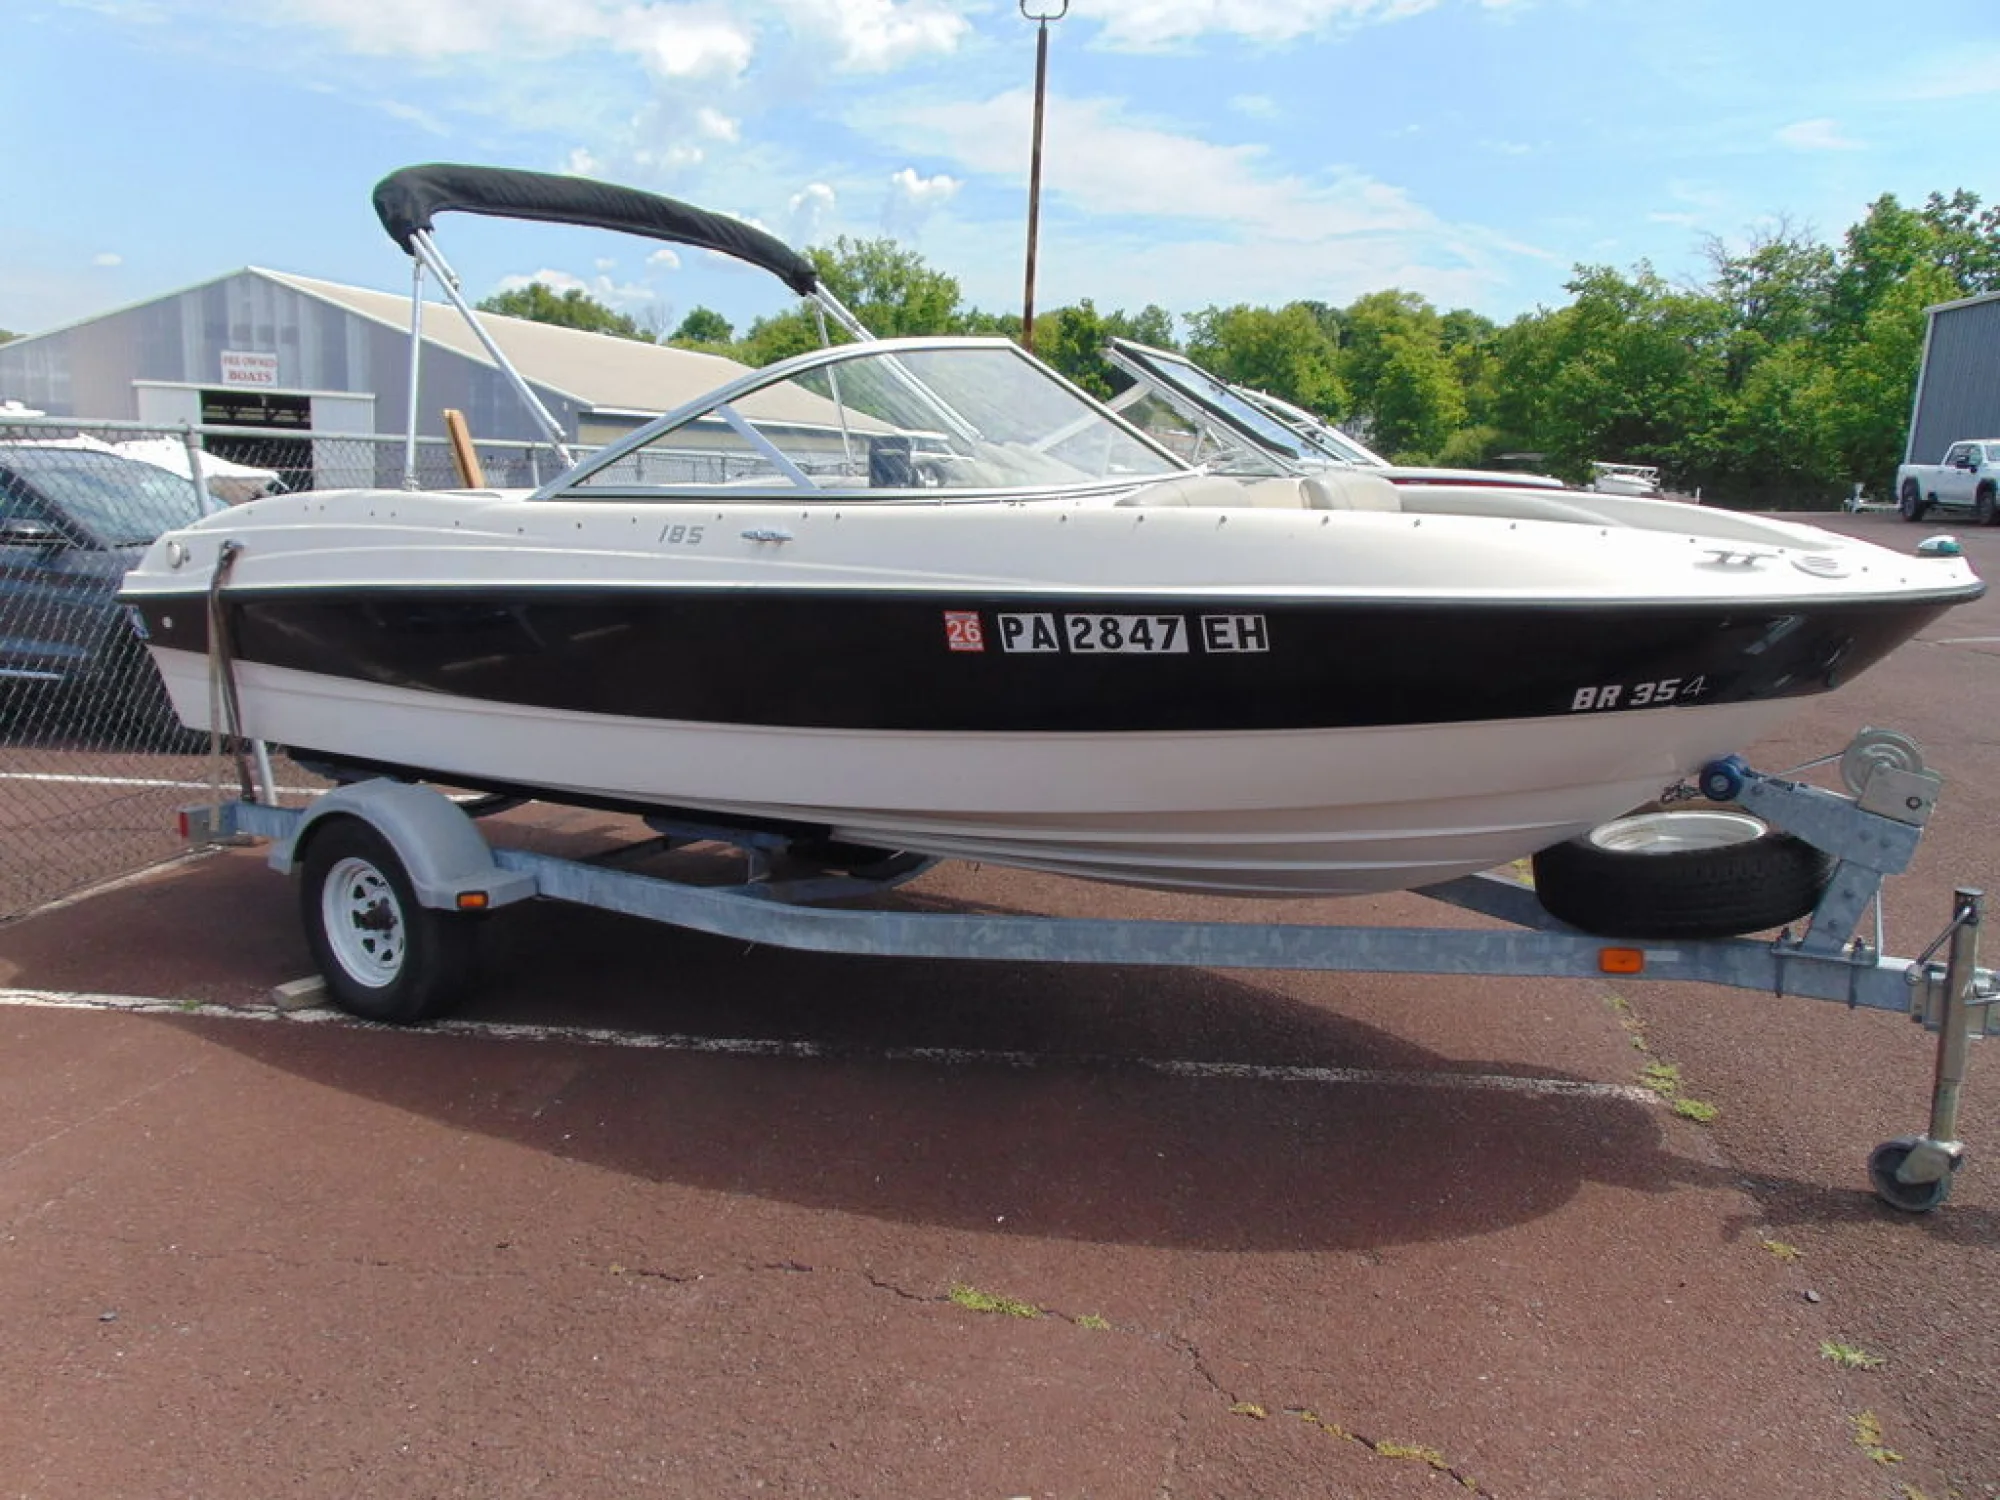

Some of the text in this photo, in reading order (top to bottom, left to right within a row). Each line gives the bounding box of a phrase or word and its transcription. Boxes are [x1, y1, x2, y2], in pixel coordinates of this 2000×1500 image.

[228, 370, 272, 382] BOATS
[658, 524, 704, 544] 185
[946, 620, 981, 642] 26
[1001, 616, 1267, 651] PA 2847 EH
[1571, 685, 1623, 711] BR
